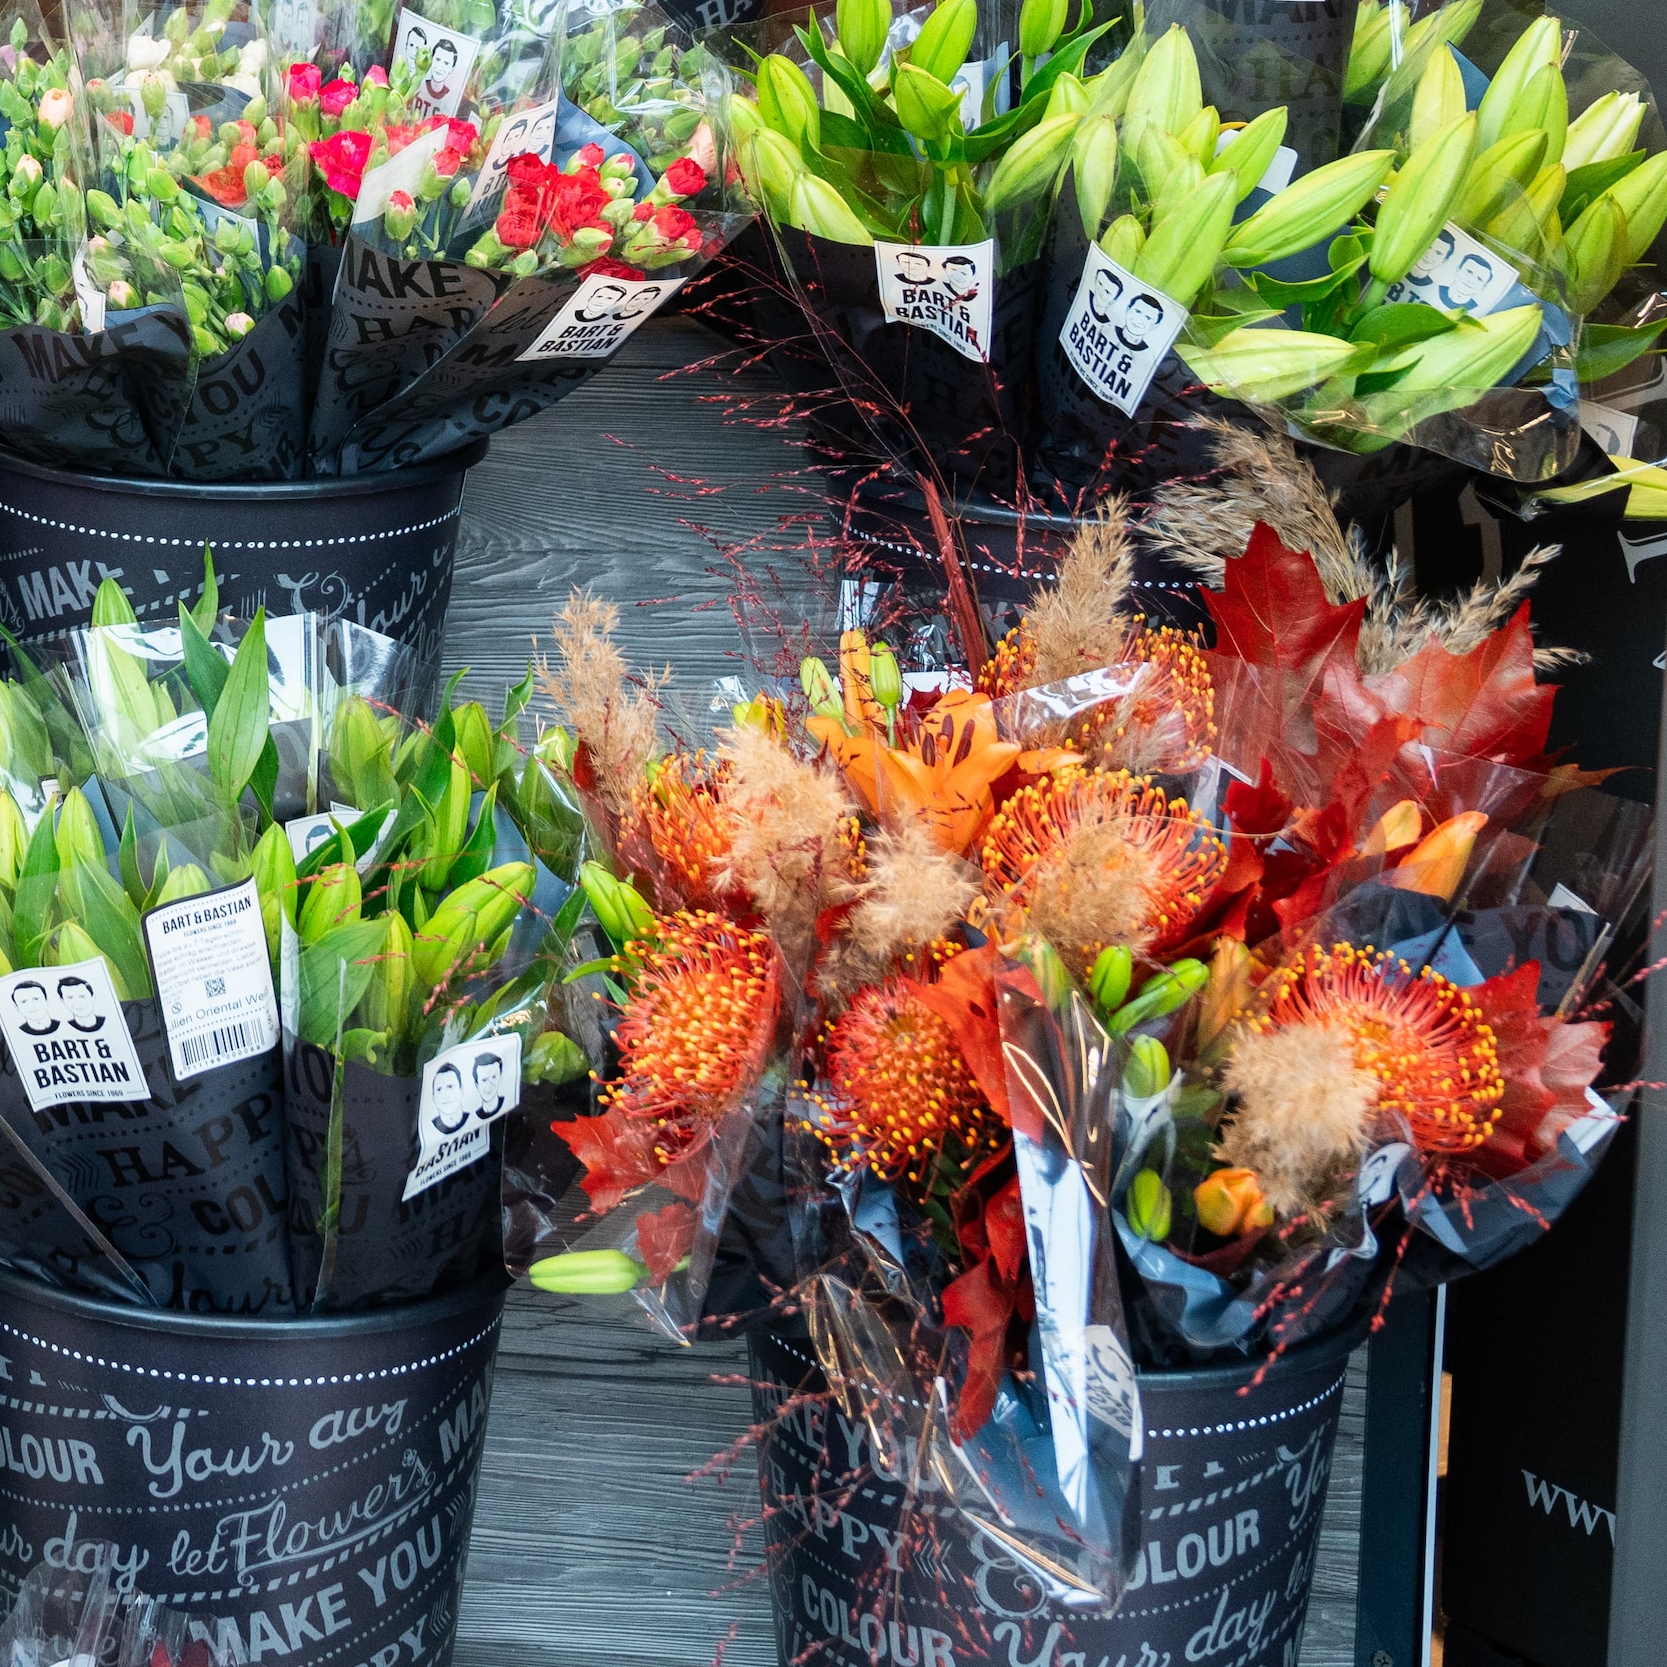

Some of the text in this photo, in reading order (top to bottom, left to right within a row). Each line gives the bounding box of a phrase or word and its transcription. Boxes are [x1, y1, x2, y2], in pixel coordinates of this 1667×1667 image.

[896, 306, 978, 346] BASTIAN
[960, 305, 971, 322] &
[537, 337, 619, 352] BASTIAN
[558, 324, 608, 338] BART
[1080, 311, 1133, 375] BART &
[1069, 324, 1133, 400] BASTIAN
[163, 896, 252, 934] BART & BASTIAN
[184, 926, 207, 937] FLOWERS
[196, 999, 243, 1021] Oriental
[32, 1035, 112, 1063] BART &
[33, 1058, 131, 1089] BASTIAN
[54, 1091, 84, 1101] FLOWERS
[126, 1421, 295, 1499] Your
[42, 1449, 437, 1592] day let Flower's
[188, 1526, 444, 1667] MAKE YOU
